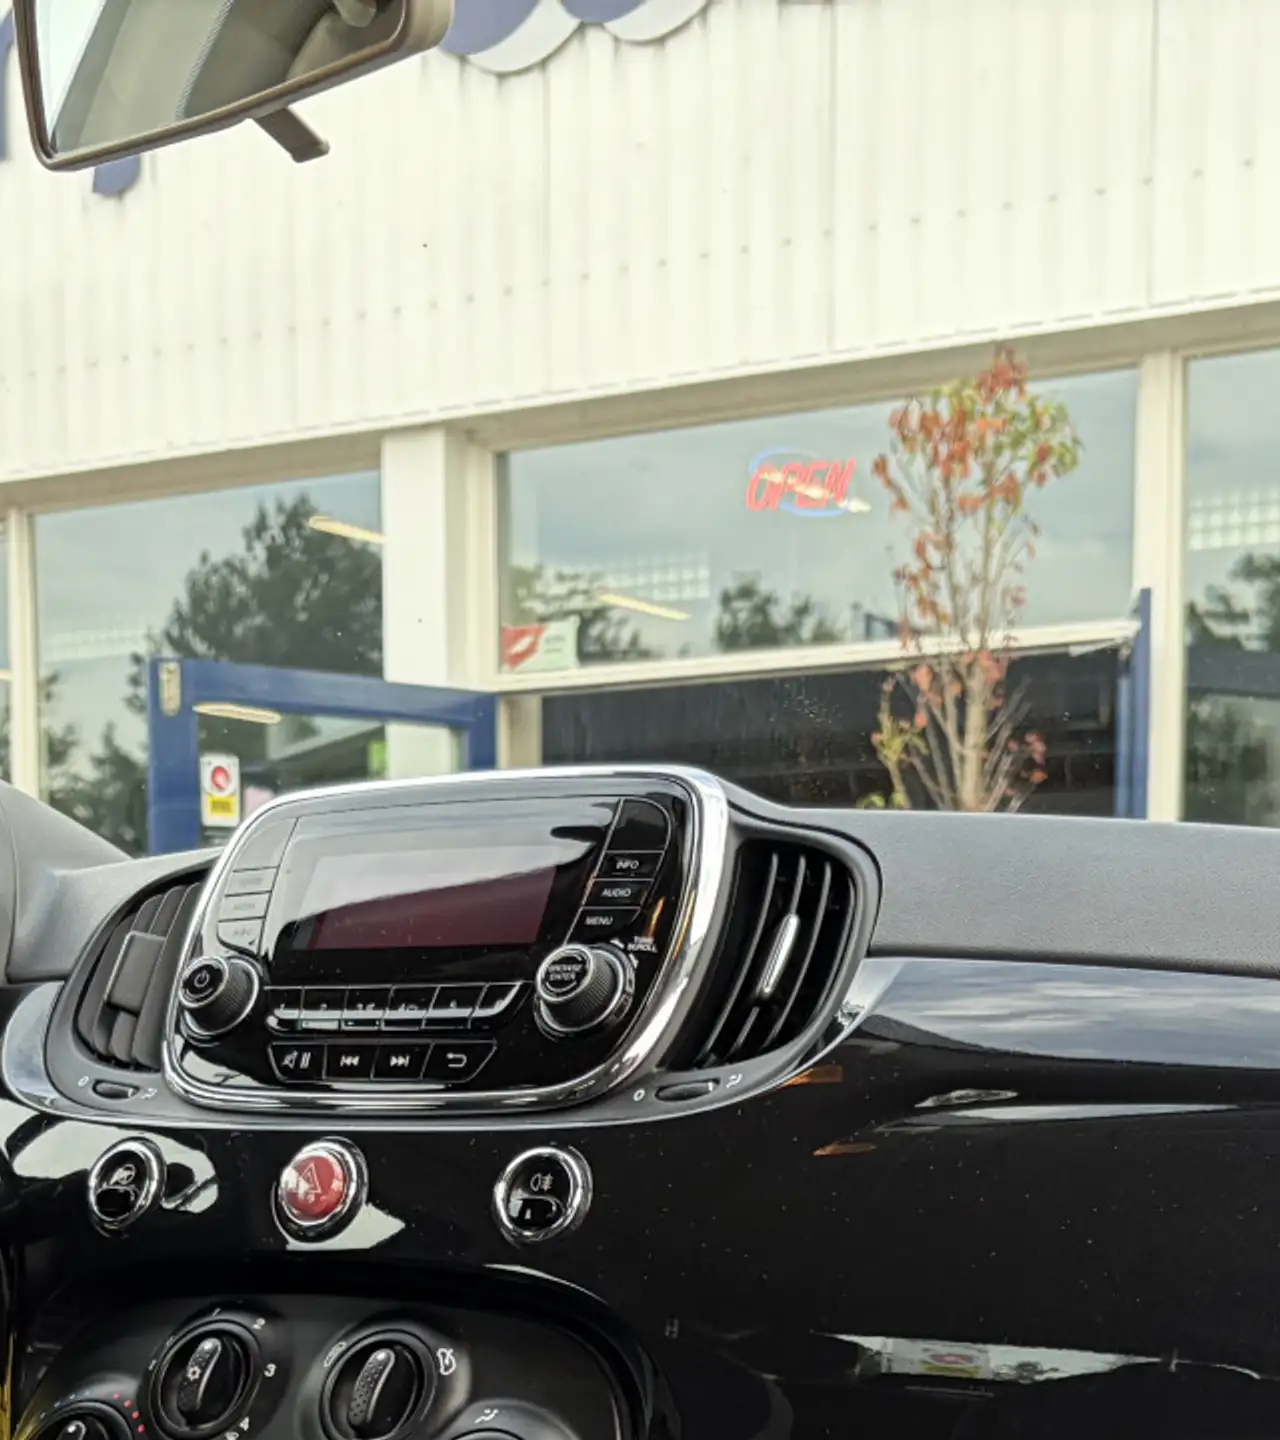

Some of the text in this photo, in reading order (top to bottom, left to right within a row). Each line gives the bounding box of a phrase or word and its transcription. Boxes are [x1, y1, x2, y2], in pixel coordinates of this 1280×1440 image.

[746, 458, 857, 512] OPEN
[615, 859, 640, 870] INFO
[600, 887, 632, 898] AUDIO
[584, 915, 614, 926] MENU
[263, 1363, 277, 1378] 3
